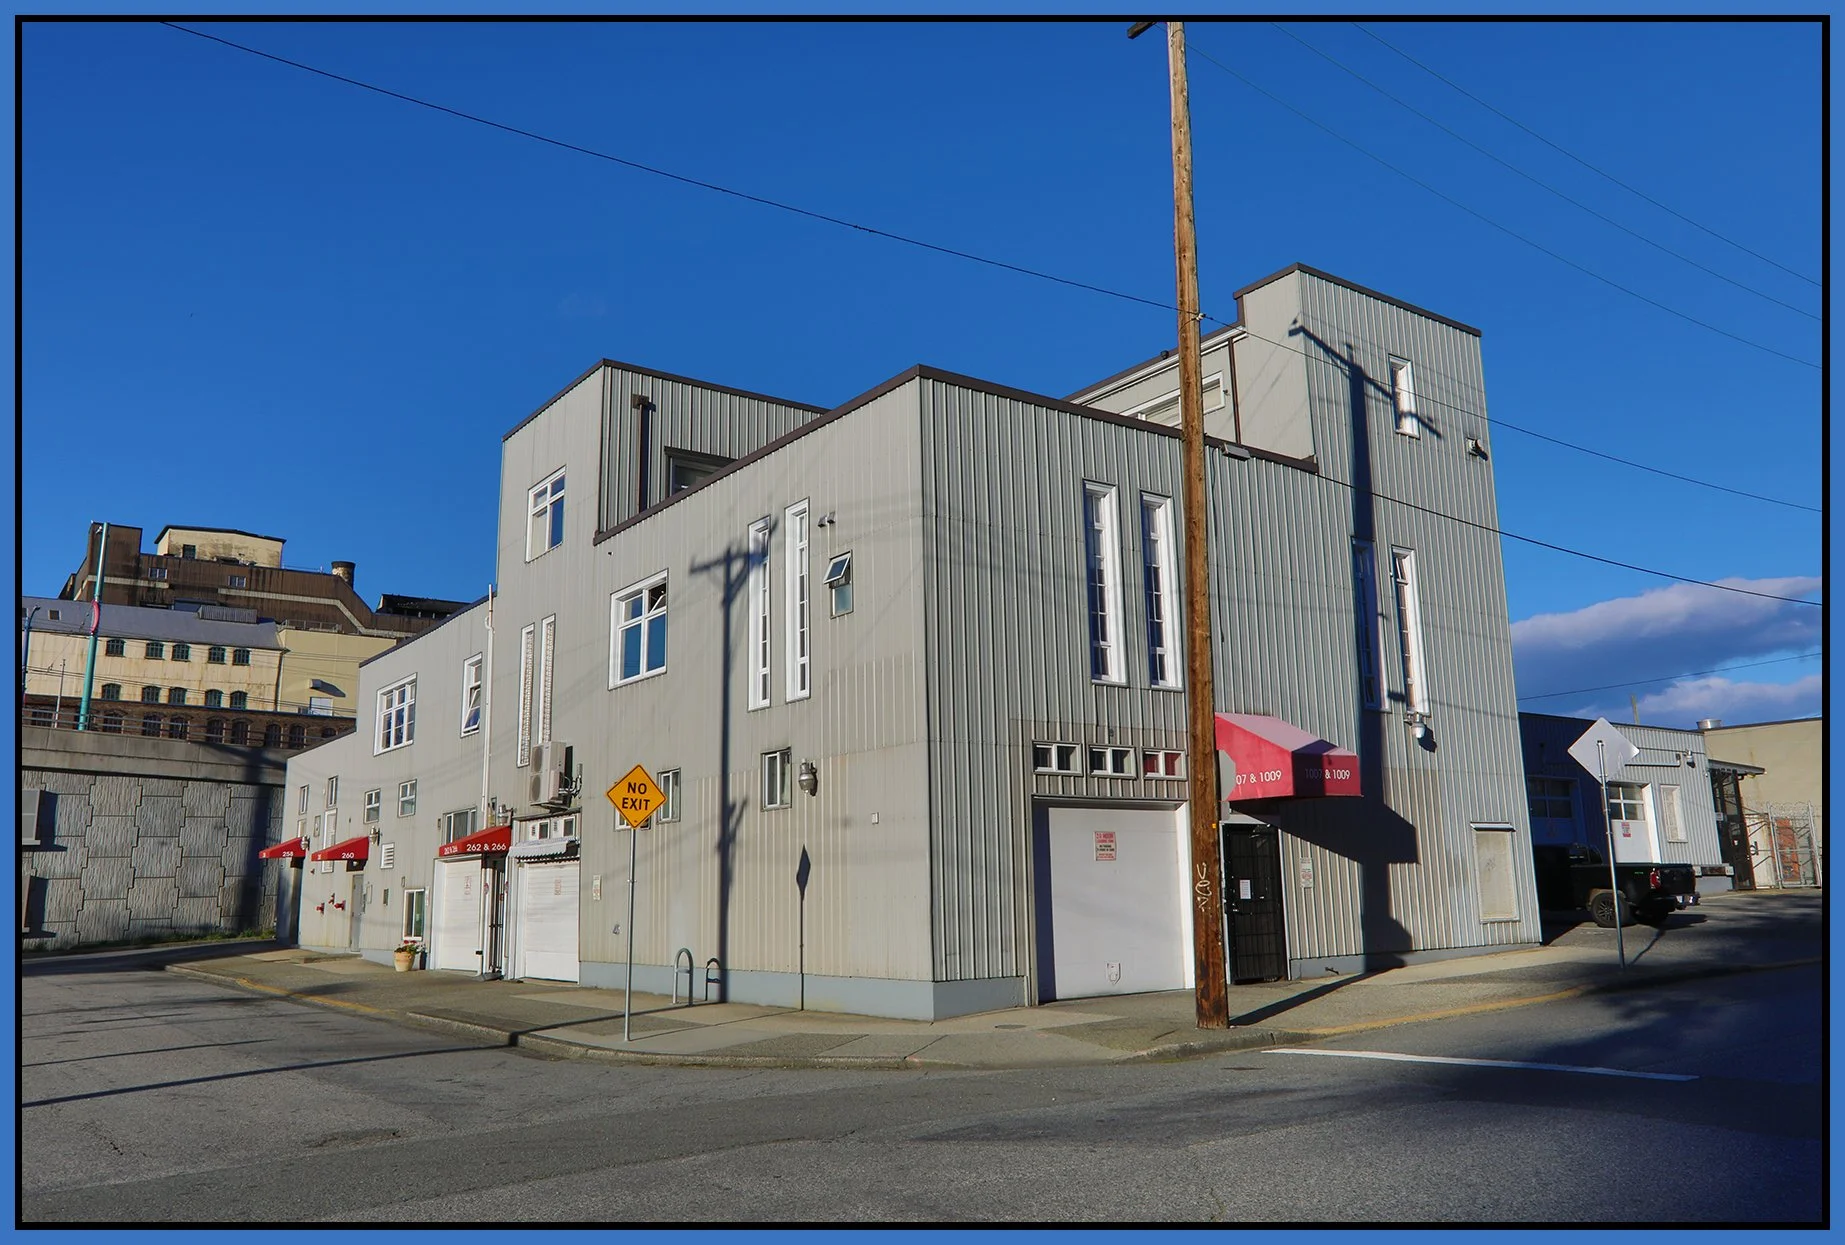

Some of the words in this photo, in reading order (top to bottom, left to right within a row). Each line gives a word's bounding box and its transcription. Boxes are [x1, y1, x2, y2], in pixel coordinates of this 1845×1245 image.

[1236, 774, 1247, 785] 07
[1249, 773, 1257, 784] &
[1259, 770, 1282, 783] 1009
[1325, 769, 1332, 780] &
[1333, 769, 1351, 780] 1009
[627, 782, 647, 795] NO
[621, 797, 650, 811] EXIT
[466, 843, 482, 852] 262
[483, 843, 490, 851] &
[491, 842, 507, 851] 266
